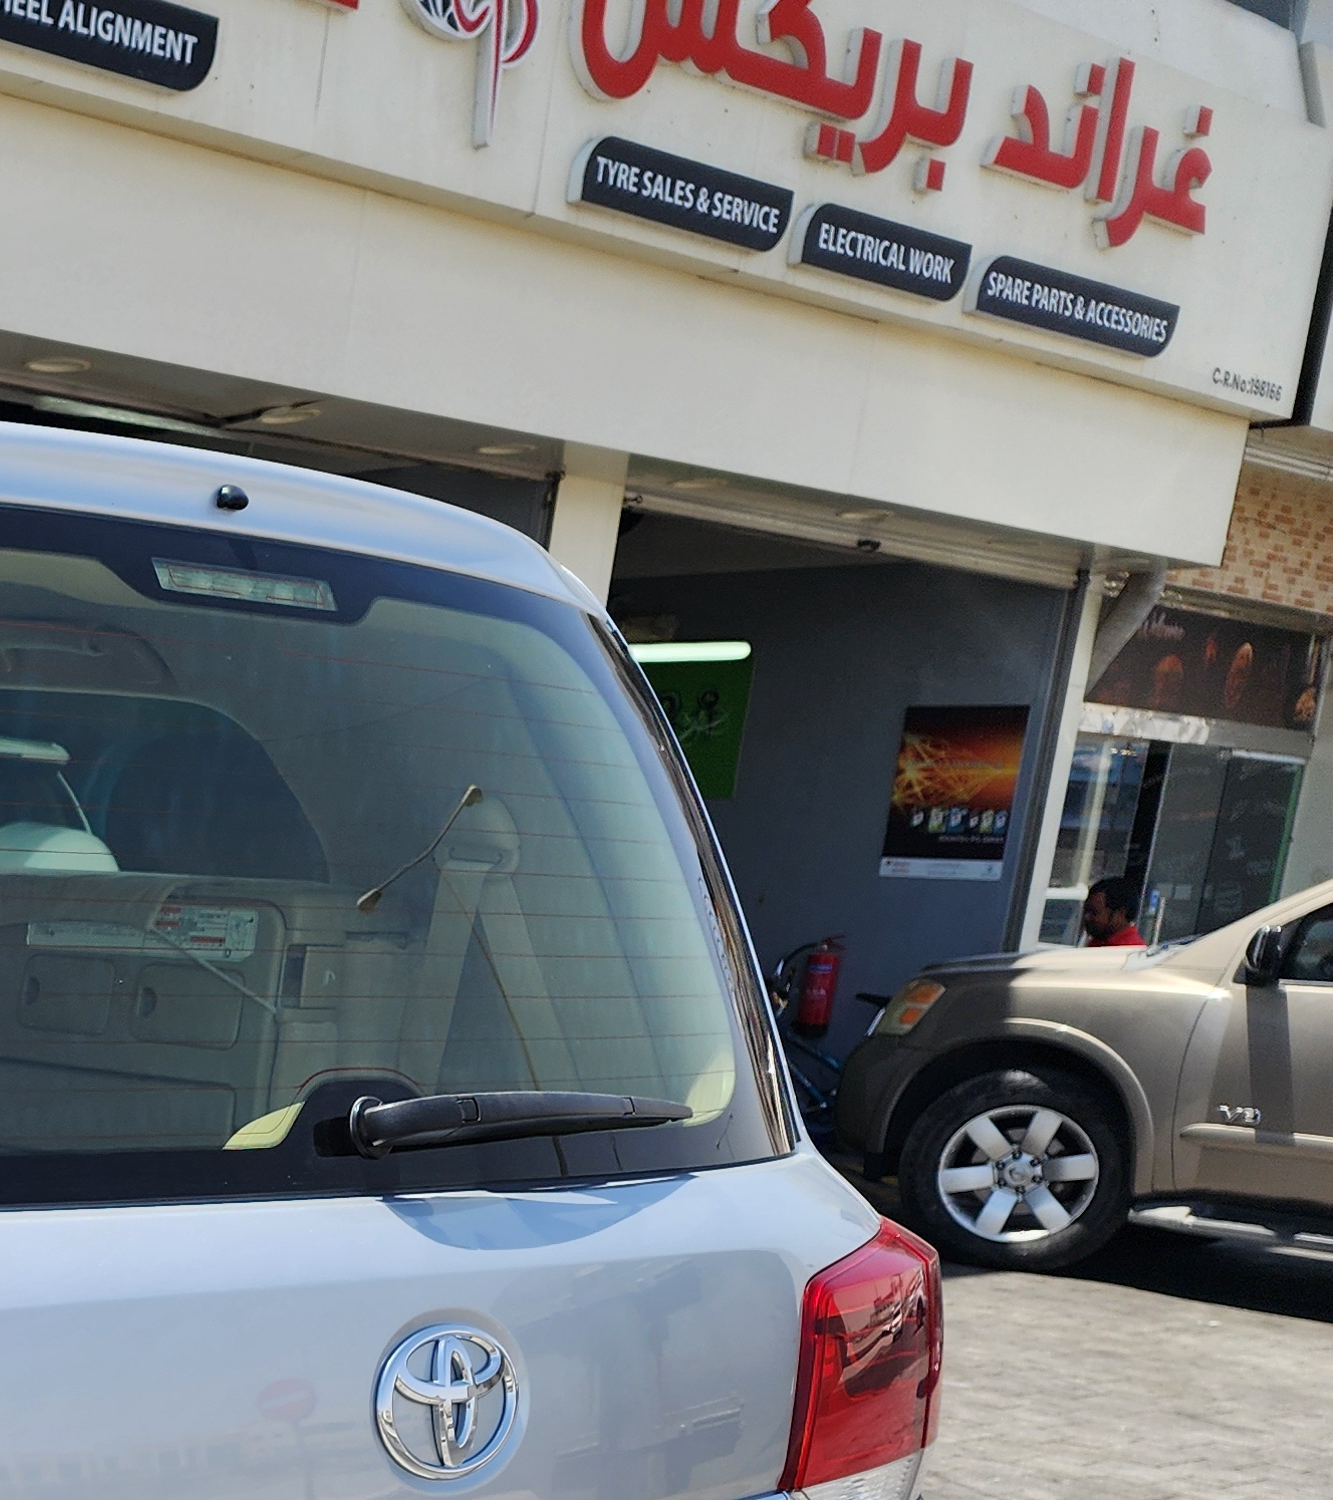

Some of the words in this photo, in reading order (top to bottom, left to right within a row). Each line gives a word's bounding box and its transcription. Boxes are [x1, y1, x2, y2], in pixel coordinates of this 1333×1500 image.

[58, 0, 199, 64] ALIGNMENT
[987, 56, 1214, 249] غراند
[596, 156, 641, 193] TYRE
[642, 170, 695, 209] SALES
[696, 187, 710, 214] &
[711, 191, 781, 234] SERVICE
[818, 222, 906, 271] ELECTRICAL
[909, 248, 955, 284] WORK
[987, 271, 1031, 303] SPARE
[1031, 285, 1074, 318] PARTS
[1074, 295, 1086, 321] &
[1086, 299, 1168, 344] ACCESSORIES
